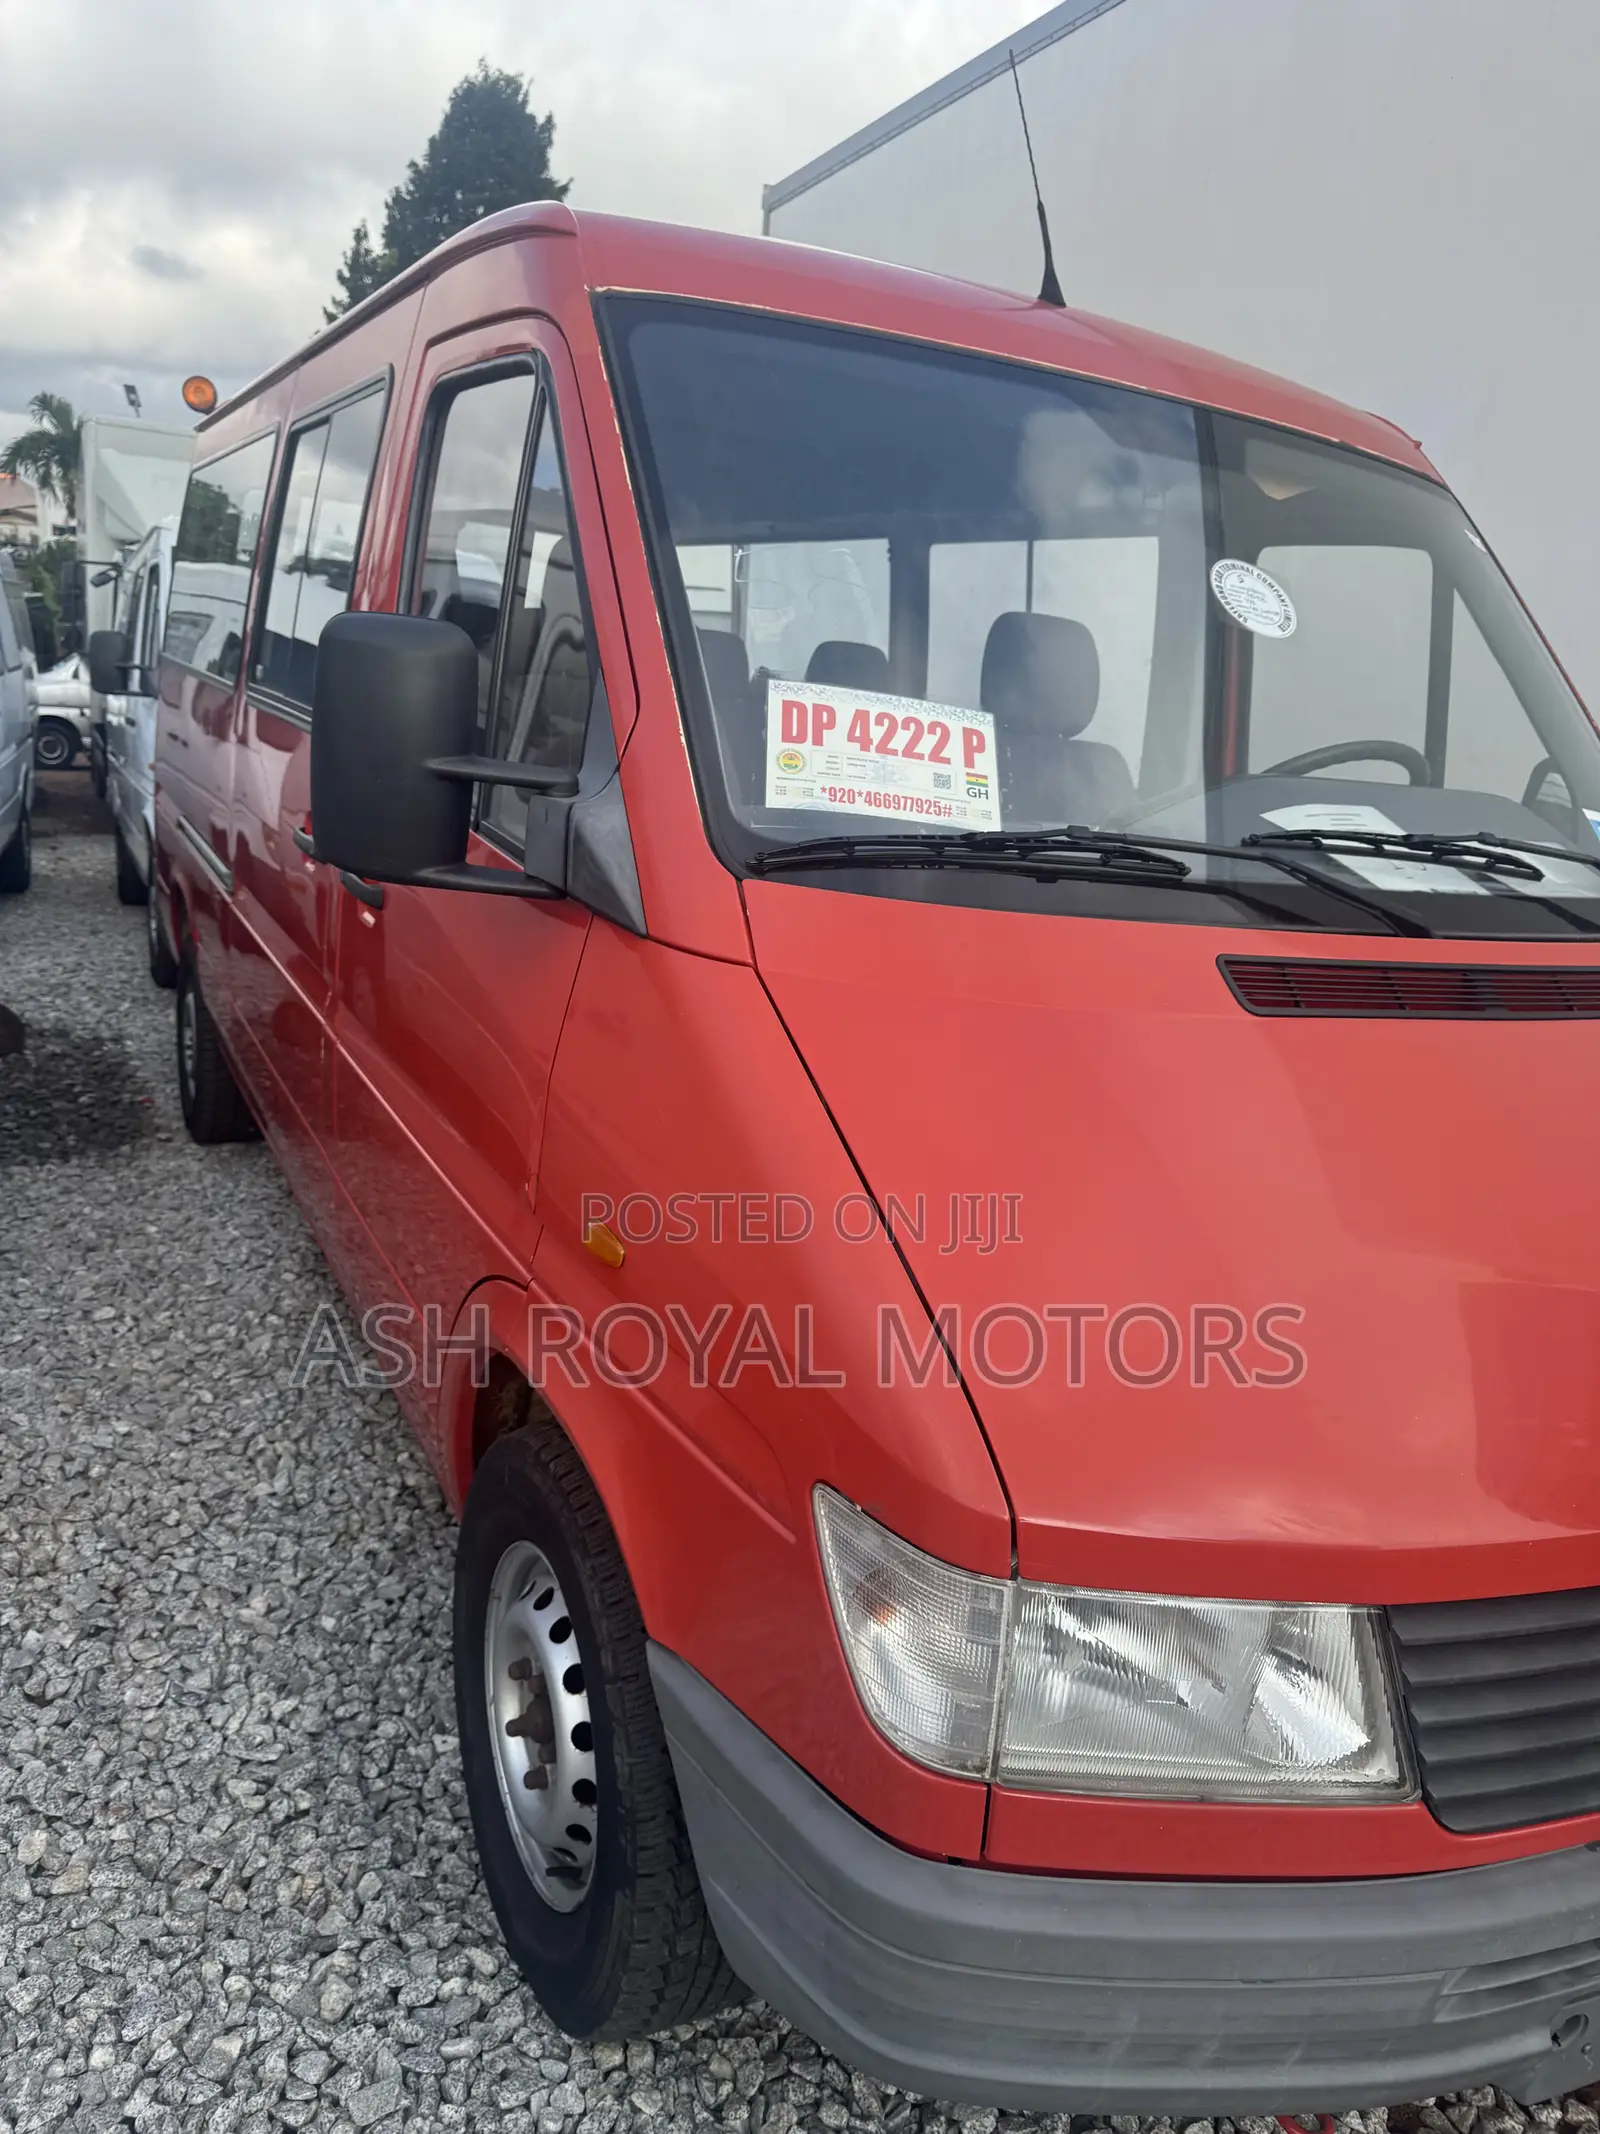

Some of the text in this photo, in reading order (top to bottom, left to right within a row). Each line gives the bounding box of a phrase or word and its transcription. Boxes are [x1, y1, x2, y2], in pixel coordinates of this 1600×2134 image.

[1218, 563, 1254, 576] TERMINAL
[1256, 572, 1290, 609] COMPANY
[1278, 609, 1292, 632] LIMITED
[781, 699, 986, 769] DP 4222 P
[966, 786, 990, 801] GH
